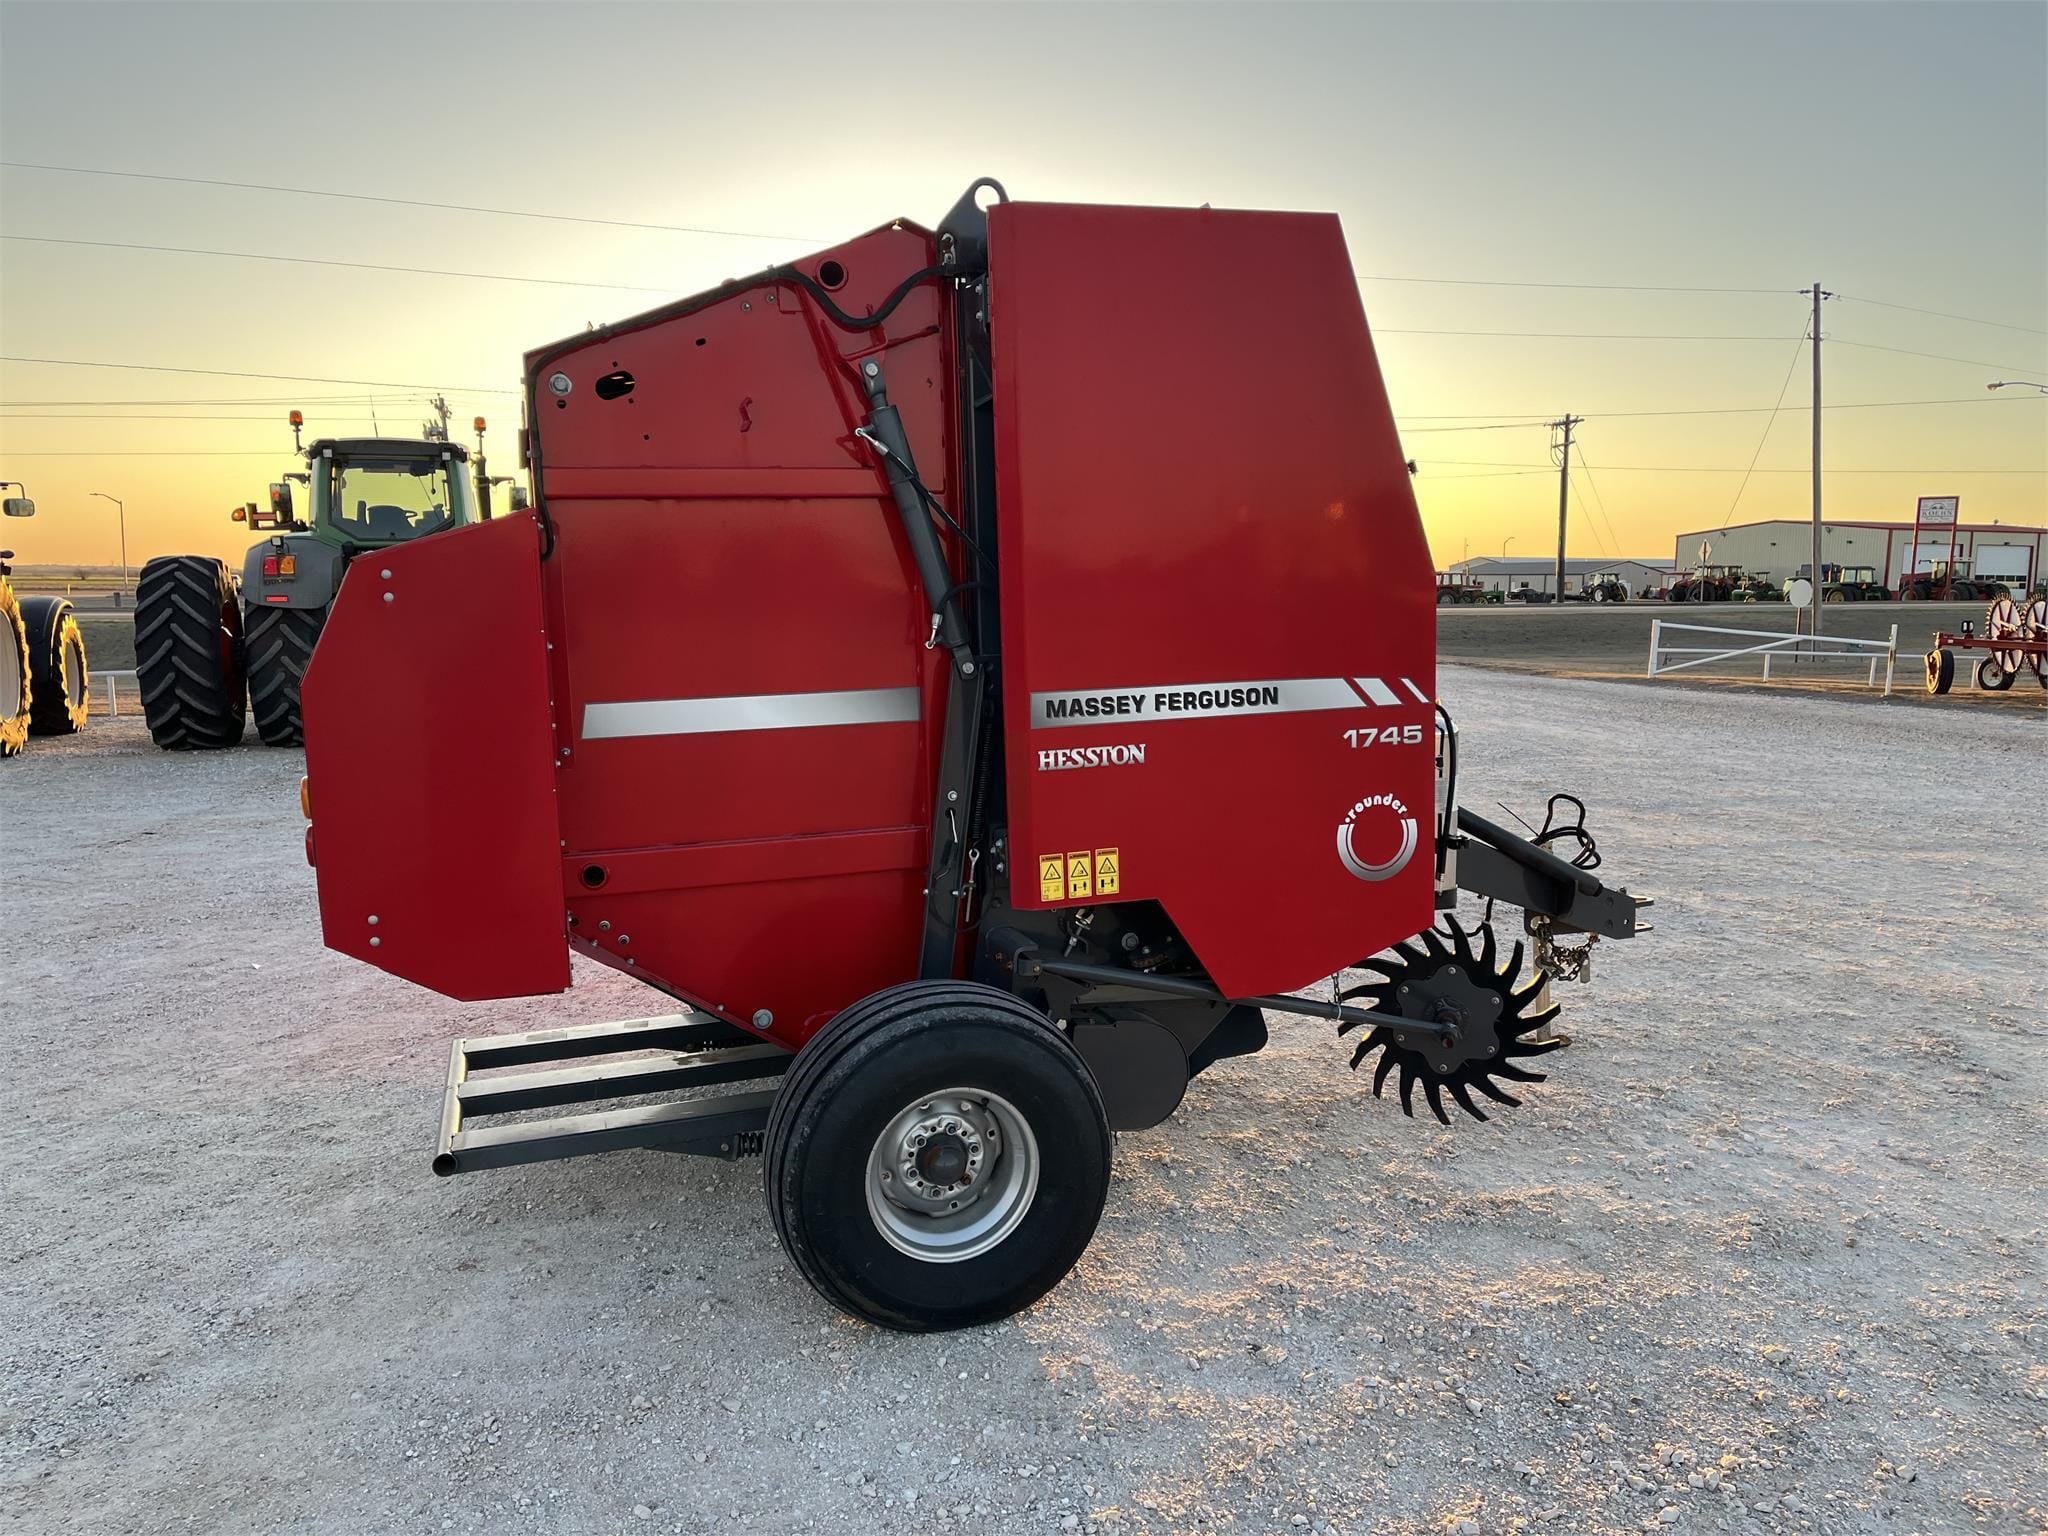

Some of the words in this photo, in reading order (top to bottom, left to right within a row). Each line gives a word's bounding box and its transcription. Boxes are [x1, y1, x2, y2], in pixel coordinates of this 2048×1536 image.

[1045, 694, 1146, 719] MASSEY
[1154, 686, 1279, 712] FERGUSON
[1343, 725, 1423, 748] 1745
[1038, 743, 1146, 771] HESSTON
[1347, 793, 1408, 820] rounder
